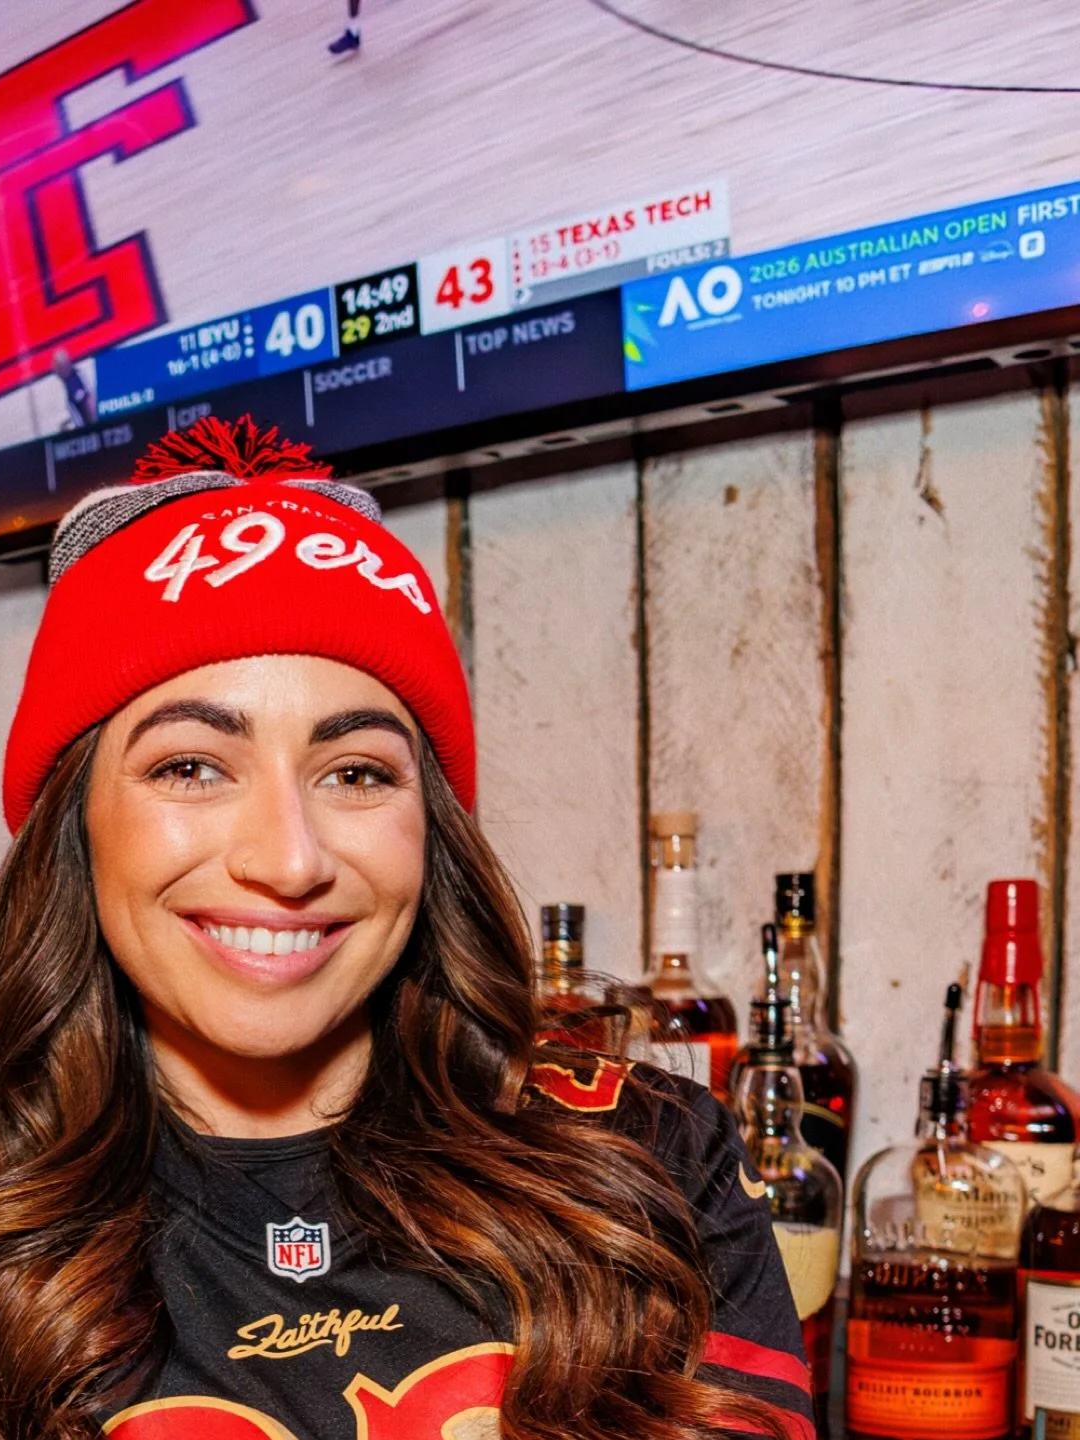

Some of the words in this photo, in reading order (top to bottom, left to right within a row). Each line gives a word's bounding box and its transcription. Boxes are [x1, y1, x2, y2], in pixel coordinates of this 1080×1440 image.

[529, 235, 551, 254] 15
[556, 210, 637, 248] TEXAS
[644, 190, 713, 225] TECH
[749, 254, 800, 284] 2026
[804, 225, 939, 270] AUSTRALIAN
[944, 210, 1008, 240] OPEN
[1017, 194, 1080, 227] FIRST
[341, 273, 410, 314] 14:49
[435, 257, 495, 310] 43
[658, 264, 743, 328] AO
[752, 281, 831, 311] TONIGHT
[835, 275, 855, 295] 10
[857, 266, 886, 289] PM
[888, 262, 912, 283] ET
[198, 318, 240, 347] BYU
[264, 303, 325, 357] 40
[341, 315, 371, 344] 29
[374, 304, 414, 335] 2nd
[465, 328, 508, 355] TOP
[512, 311, 576, 345] NEWS
[314, 357, 392, 393] SOCCER
[277, 1243, 321, 1269] NFL
[227, 1303, 405, 1360] Faithful
